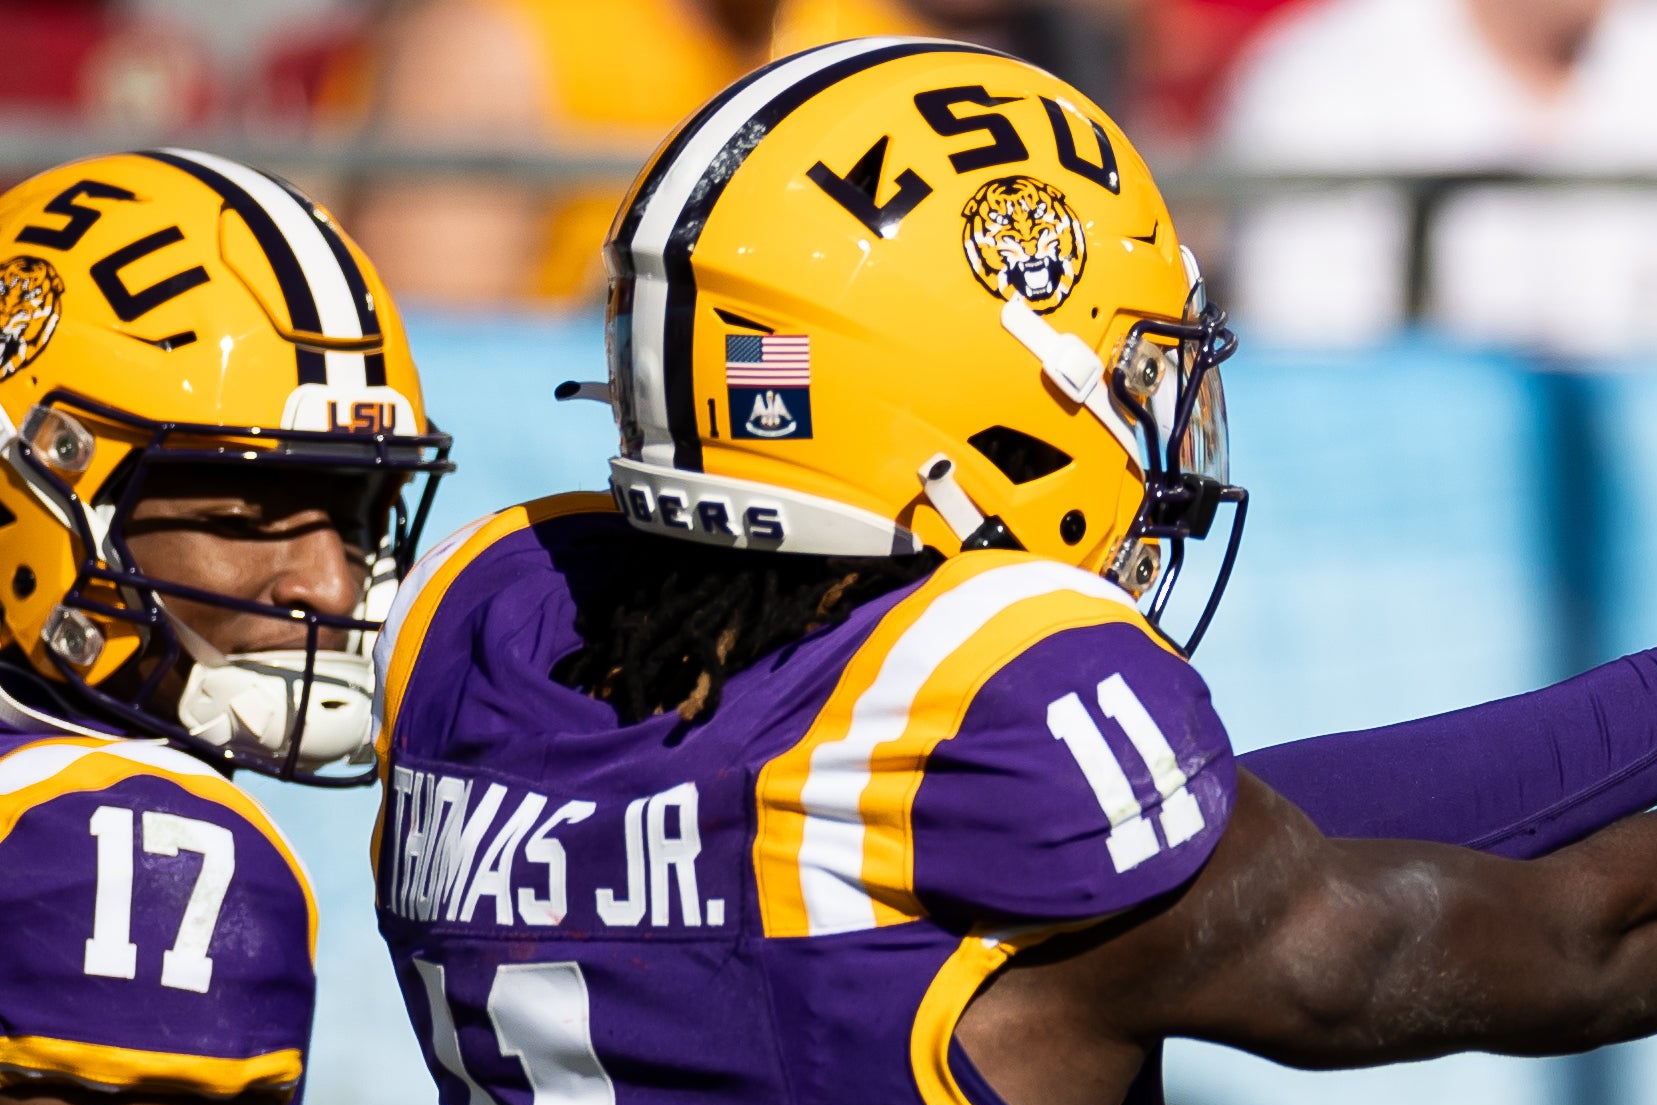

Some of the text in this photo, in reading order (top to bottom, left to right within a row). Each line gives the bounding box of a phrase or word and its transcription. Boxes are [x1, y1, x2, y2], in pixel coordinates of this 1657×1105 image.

[806, 84, 1120, 238] LSU
[327, 401, 396, 433] LSU
[607, 482, 784, 541] IGERS
[391, 765, 725, 927] THOMAS JR.
[1046, 672, 1204, 875] 11
[84, 805, 236, 993] 17
